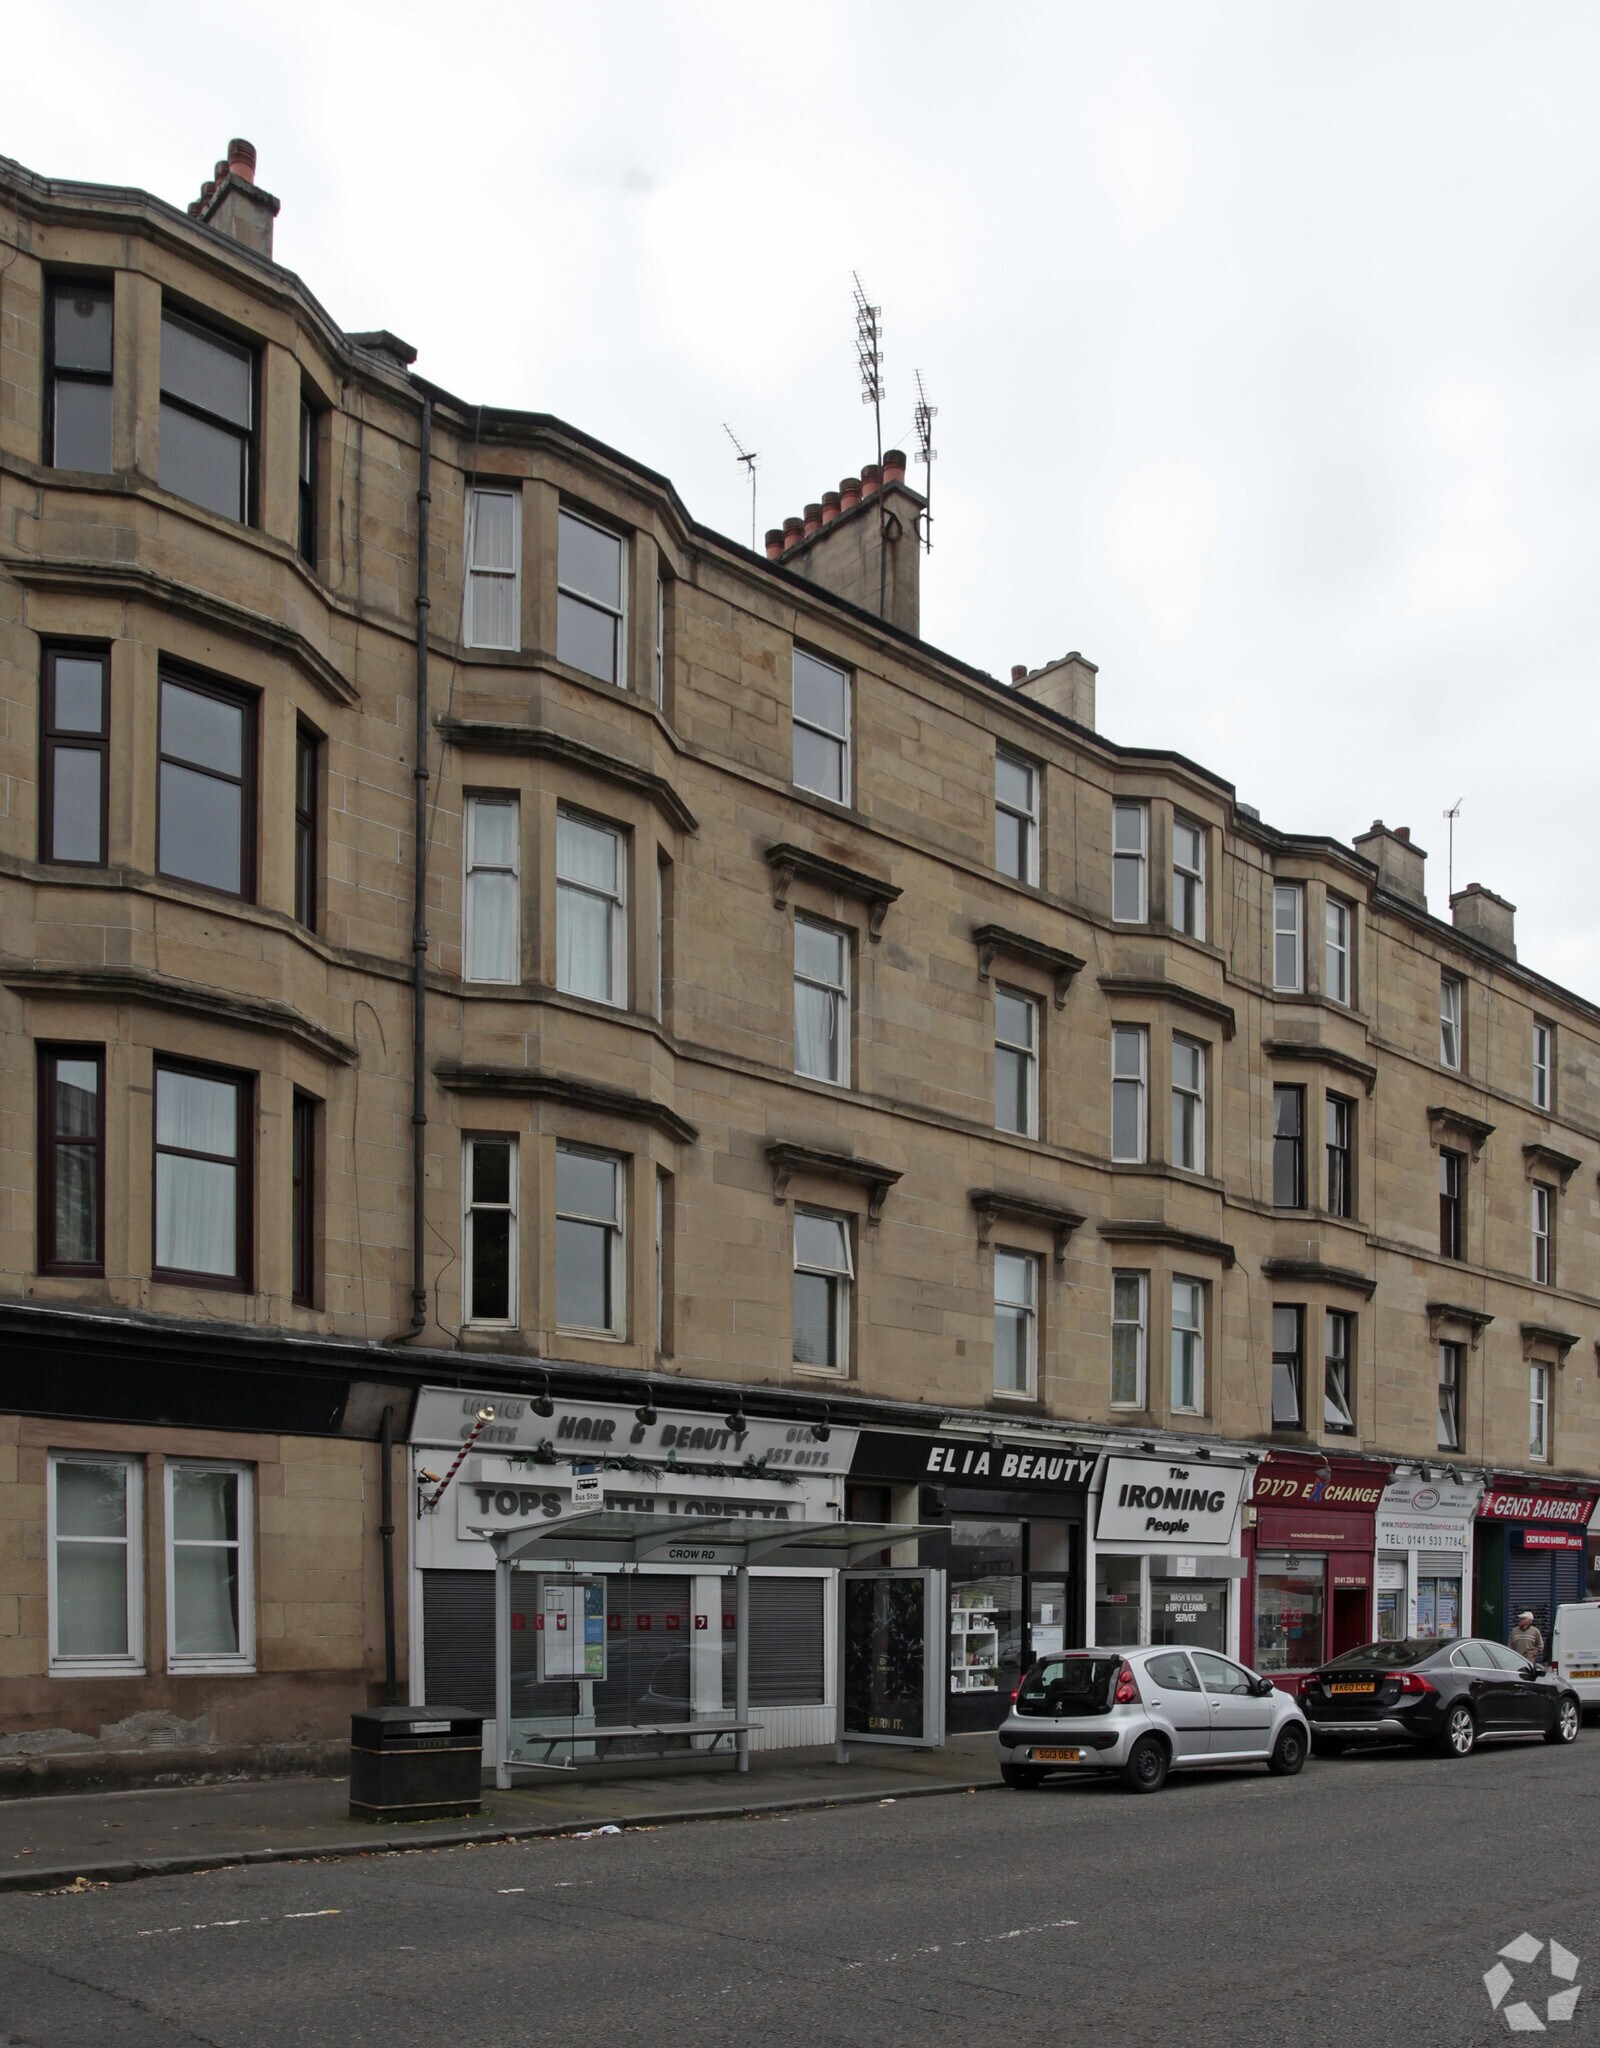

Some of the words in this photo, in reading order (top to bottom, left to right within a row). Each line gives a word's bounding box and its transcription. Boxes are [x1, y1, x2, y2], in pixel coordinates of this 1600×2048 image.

[461, 1423, 518, 1443] GNTS
[557, 1415, 617, 1442] HAIR
[660, 1424, 750, 1451] BEAUTY
[926, 1447, 990, 1475] ELIA
[1001, 1453, 1094, 1482] BEAUTY
[1169, 1467, 1190, 1480] The
[575, 1493, 585, 1501] Bus
[586, 1492, 600, 1501] Stop
[1256, 1477, 1299, 1497] DVD
[1301, 1480, 1381, 1503] EXCHANGE
[475, 1489, 562, 1517] TOPS
[604, 1496, 655, 1514] ITH
[1118, 1484, 1226, 1512] IRONING
[1494, 1495, 1534, 1516] GENTS
[1532, 1499, 1582, 1520] BARBERS
[1145, 1517, 1190, 1535] People
[1385, 1534, 1404, 1545] TEL:
[1407, 1535, 1426, 1545] 0141
[1429, 1536, 1442, 1546] 533
[669, 1549, 700, 1559] CROW
[701, 1551, 715, 1559] RD
[1182, 1603, 1208, 1612] CLEANING
[1175, 1613, 1197, 1622] SERVICE
[1334, 1684, 1354, 1692] AK60
[1355, 1683, 1372, 1691] CCZ
[868, 1716, 890, 1729] EARN
[893, 1718, 904, 1730] IT.
[417, 1740, 450, 1748] LITTER
[1039, 1750, 1056, 1759] SG13
